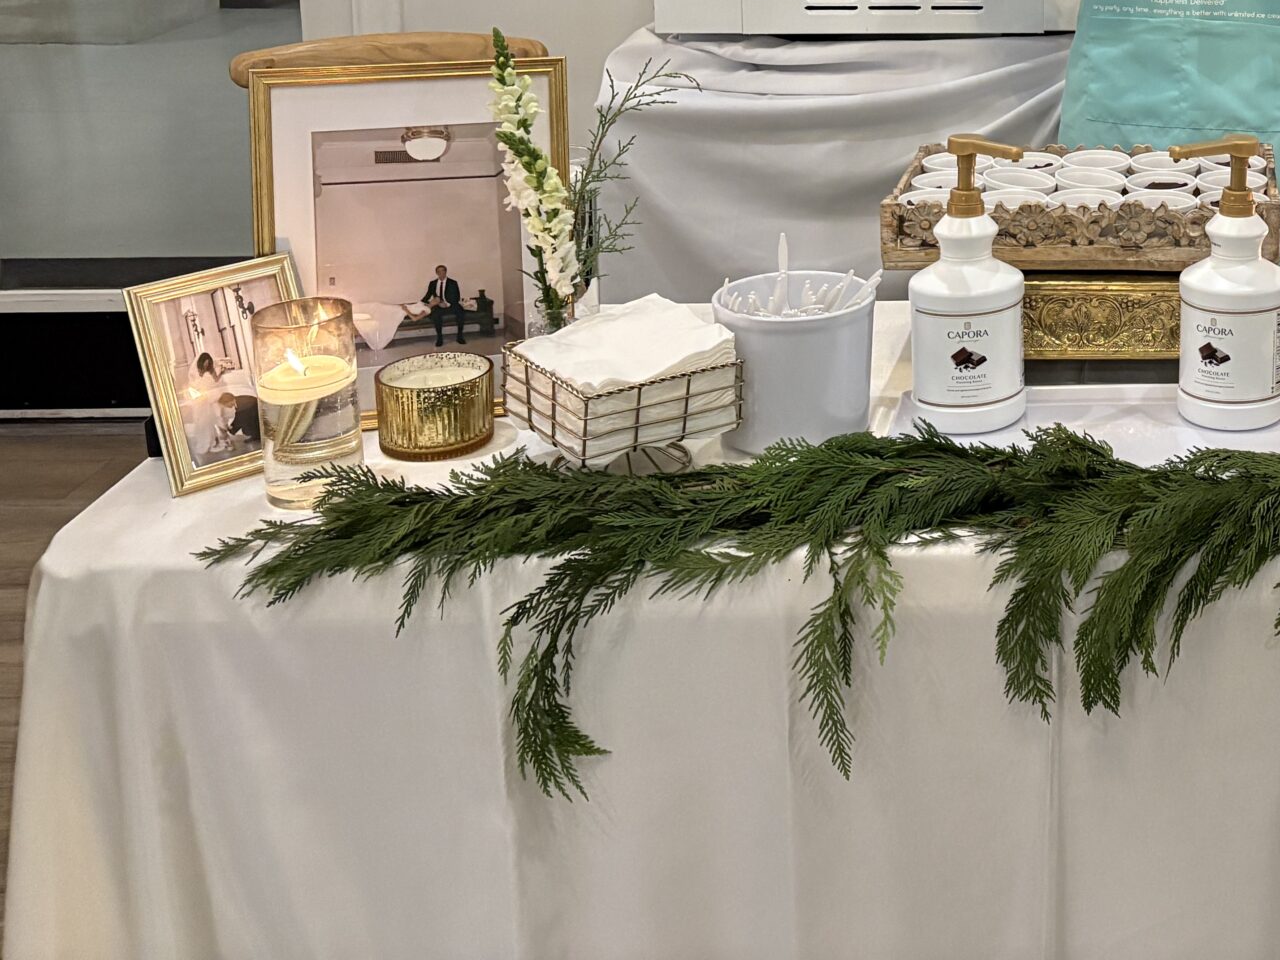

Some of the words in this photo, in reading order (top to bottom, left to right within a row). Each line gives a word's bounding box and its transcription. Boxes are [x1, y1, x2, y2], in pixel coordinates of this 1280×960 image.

[1153, 8, 1184, 17] everything
[947, 329, 989, 339] CAPORA
[1196, 324, 1234, 336] CAPORA
[1198, 368, 1229, 377] CHOCOLATE
